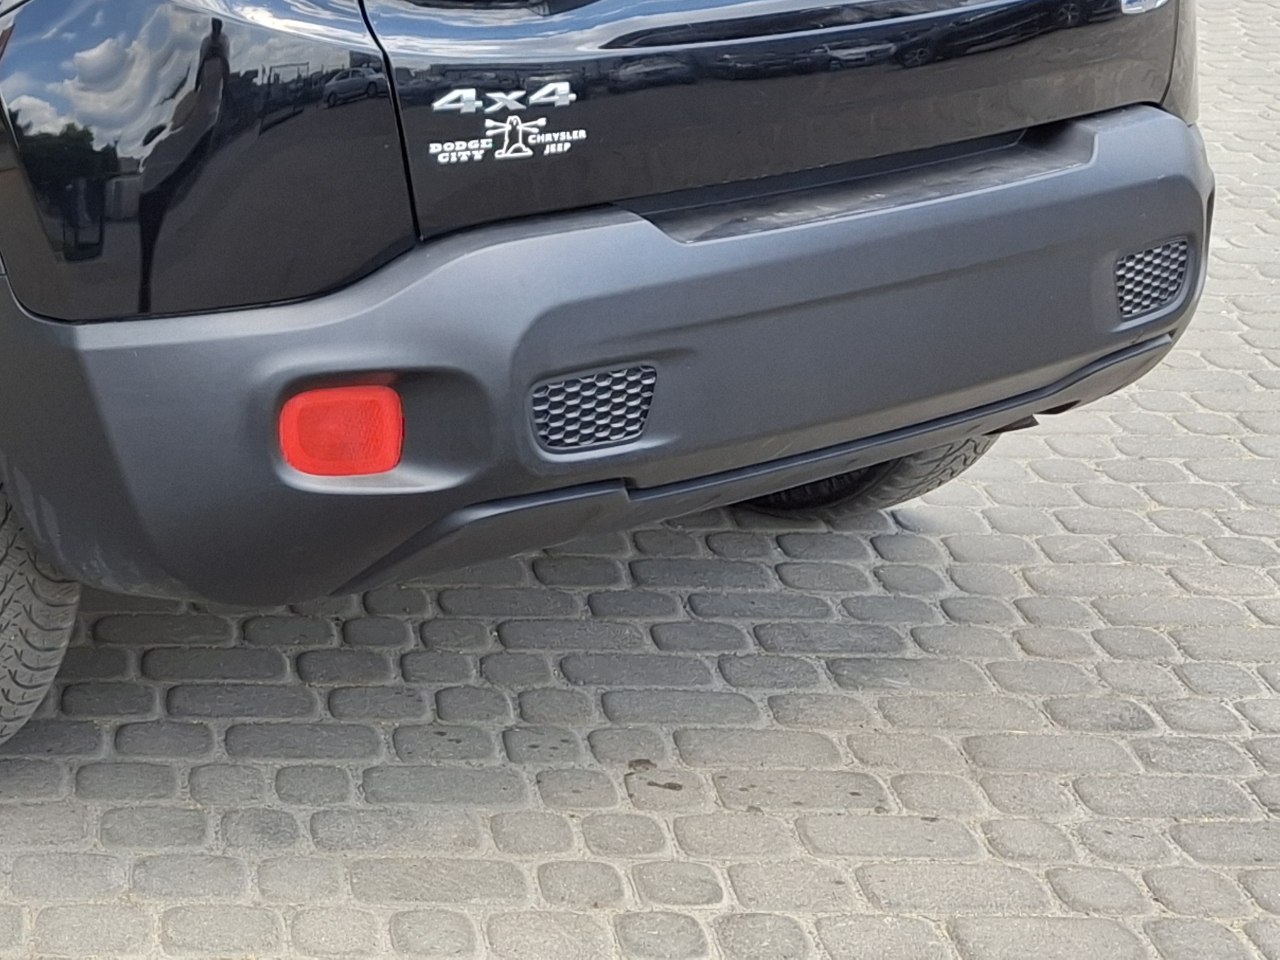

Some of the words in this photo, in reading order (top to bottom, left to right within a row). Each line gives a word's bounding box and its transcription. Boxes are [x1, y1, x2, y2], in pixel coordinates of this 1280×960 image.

[431, 81, 578, 114] 4x4
[527, 129, 588, 145] CHRYSLER
[428, 138, 494, 154] DODGE
[543, 142, 572, 156] JEEP
[437, 149, 486, 164] CITY
